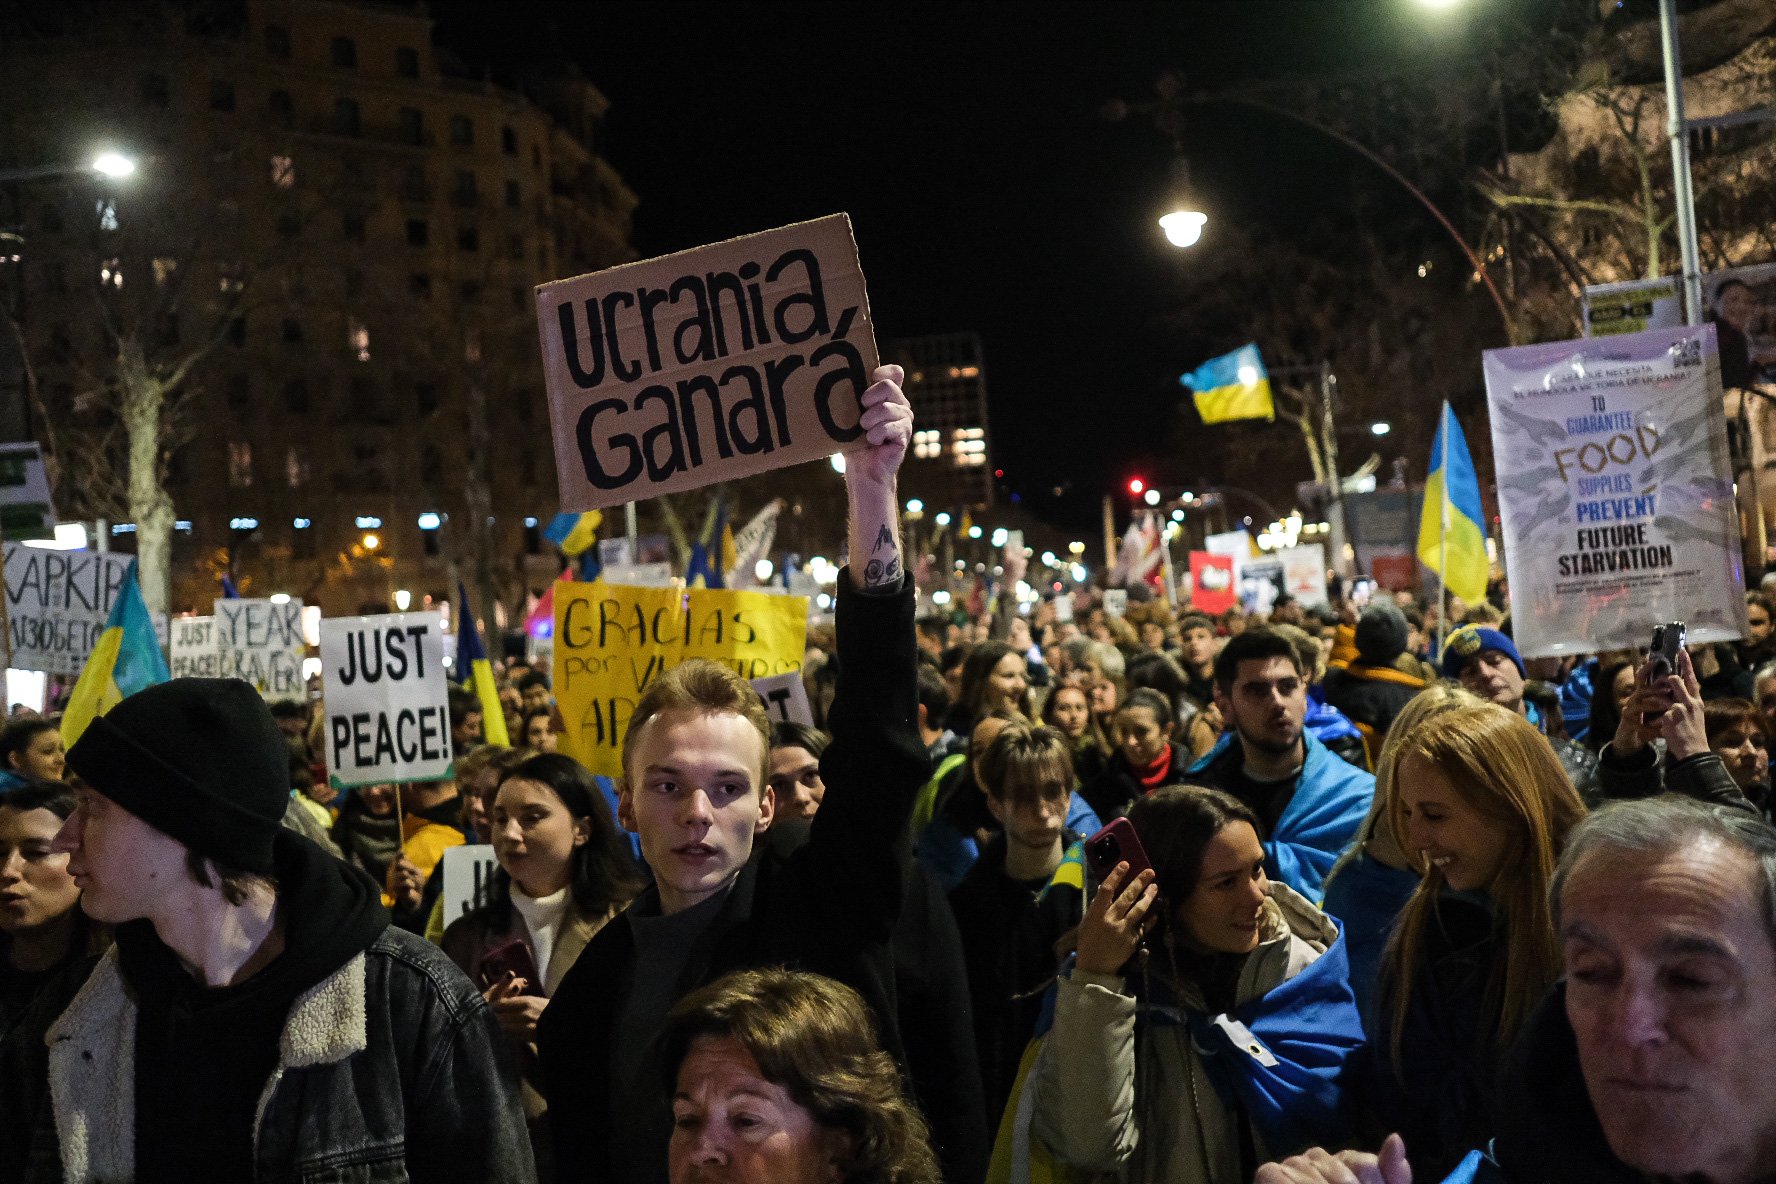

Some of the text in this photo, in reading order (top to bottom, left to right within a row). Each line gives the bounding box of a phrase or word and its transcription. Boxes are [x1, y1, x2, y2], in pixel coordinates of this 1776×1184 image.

[576, 306, 868, 490] Ganará
[1591, 394, 1606, 412] TO
[1566, 410, 1633, 435] GUARANTEE
[1554, 426, 1663, 482] FOOD
[1578, 473, 1633, 496] SUPPLIES
[1577, 494, 1656, 523] PREVENT
[1577, 523, 1648, 550] FUTURE
[1558, 545, 1673, 576] STARVATION
[177, 621, 213, 646] JUST
[221, 601, 304, 647] YEAR
[563, 597, 756, 649] GRACIAS
[338, 625, 429, 686] JUST
[332, 706, 449, 769] PEACE!
